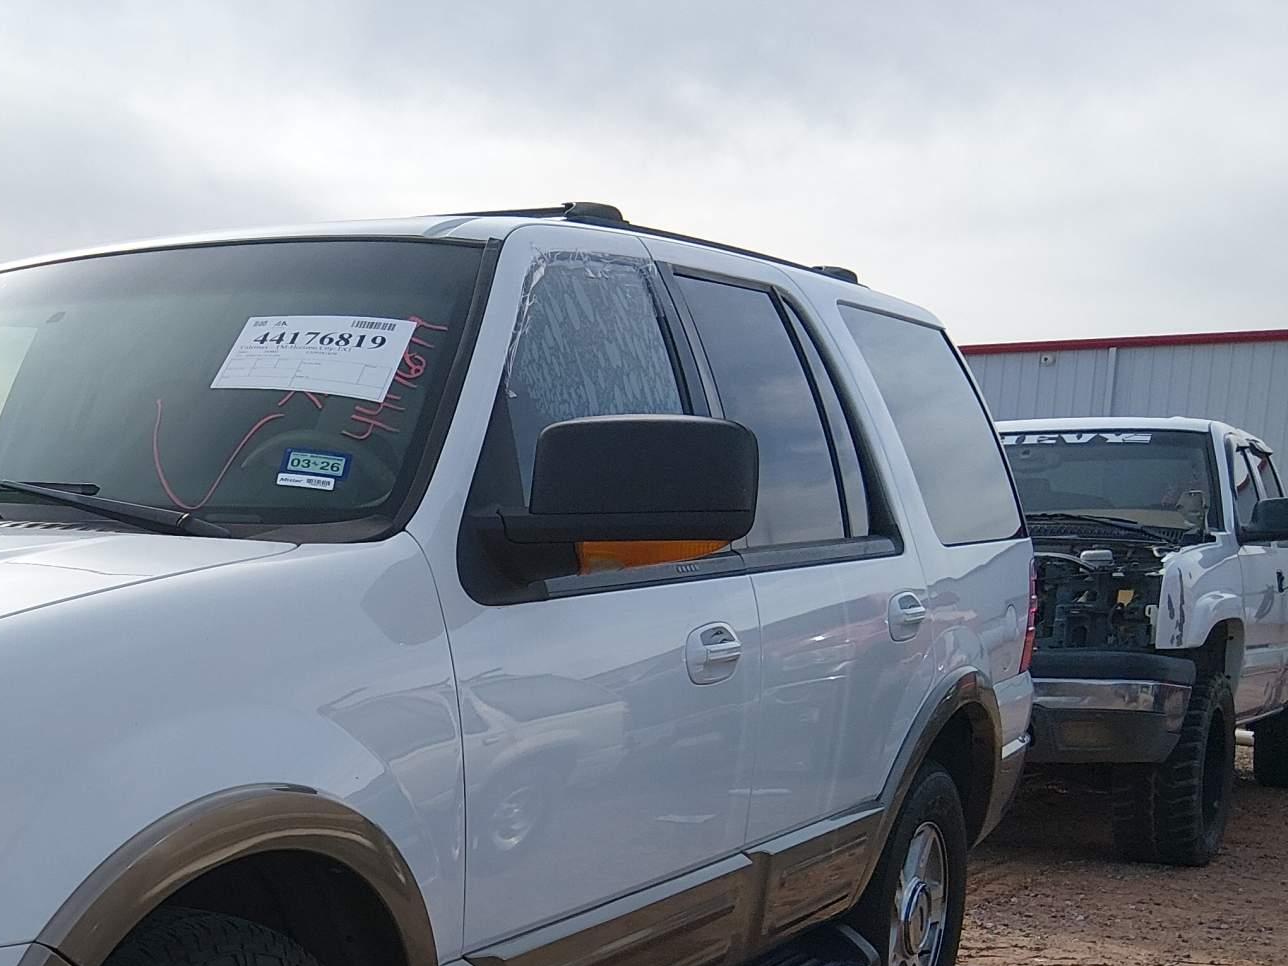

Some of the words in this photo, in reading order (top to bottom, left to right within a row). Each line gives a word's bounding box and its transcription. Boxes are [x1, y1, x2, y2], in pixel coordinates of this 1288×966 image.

[253, 331, 387, 350] 44176819
[291, 458, 311, 468] 03
[319, 461, 342, 472] 26
